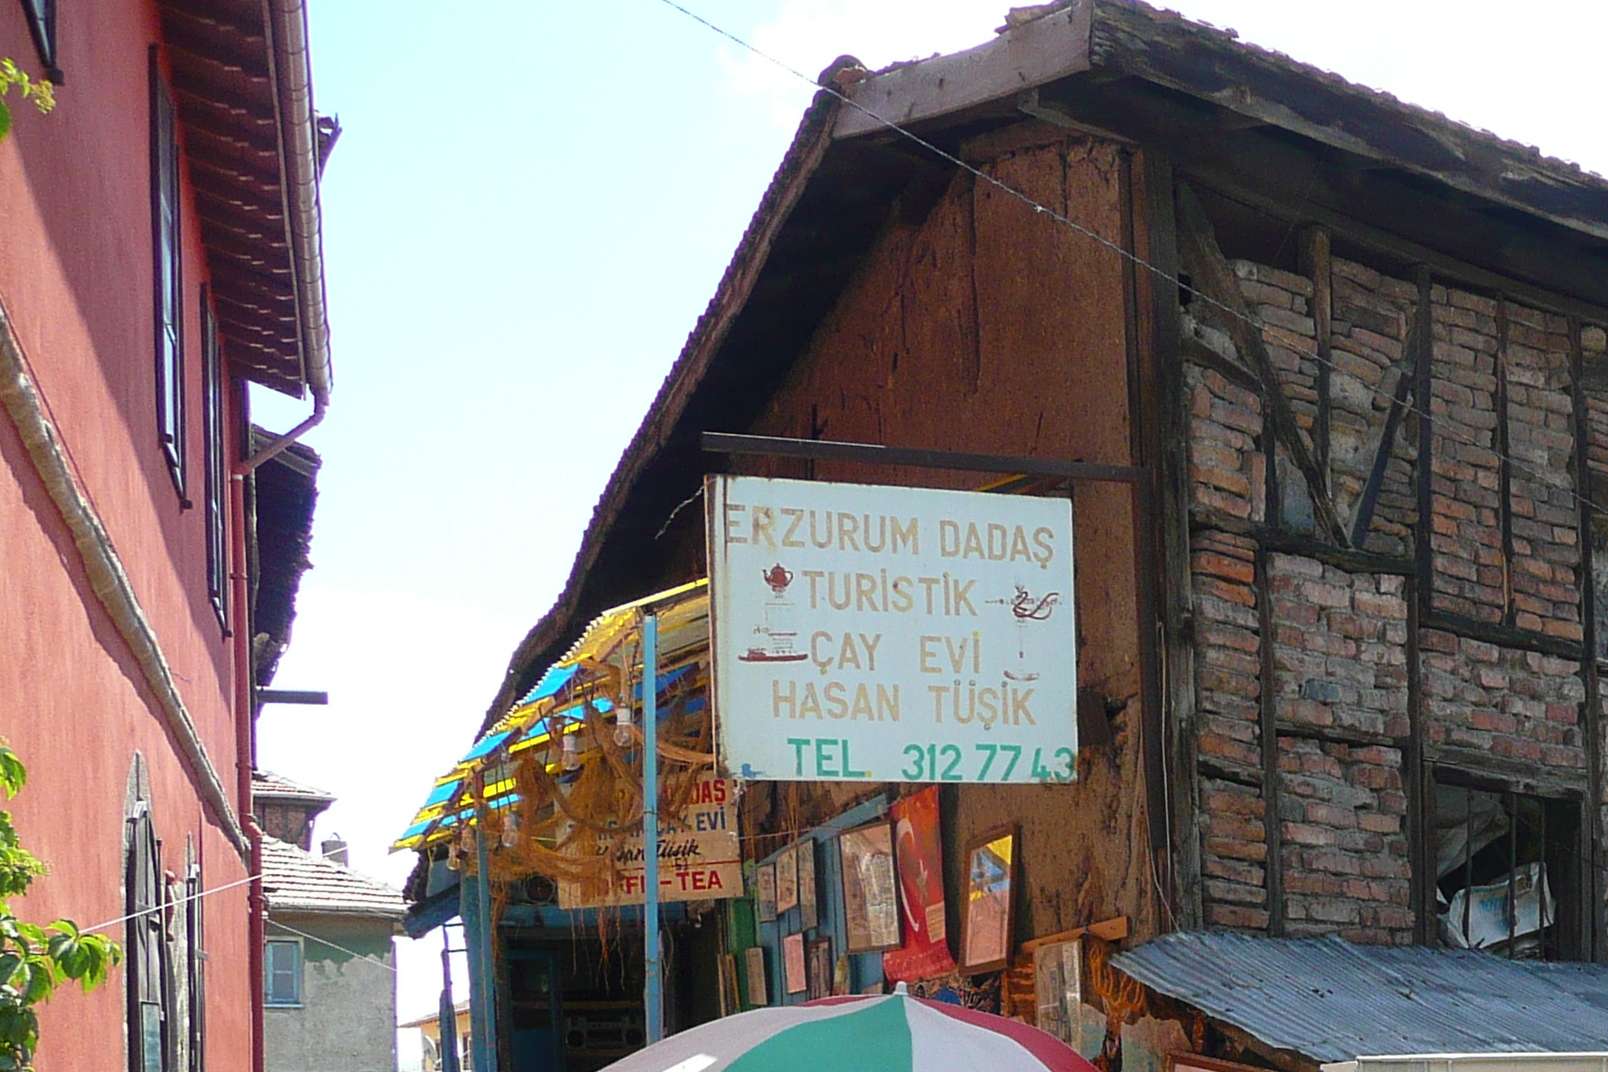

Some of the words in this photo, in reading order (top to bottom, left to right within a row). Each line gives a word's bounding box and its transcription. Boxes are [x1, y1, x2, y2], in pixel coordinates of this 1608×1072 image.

[727, 503, 919, 555] ERZURUM
[939, 519, 1054, 570] DADAŞ
[802, 568, 978, 616] TURİSTİK
[810, 630, 883, 676] ÇAY
[919, 630, 981, 674] EVİ
[772, 679, 900, 722] HASAN
[927, 679, 1037, 731] TÜŞİK
[901, 743, 963, 781] 312
[975, 744, 1022, 782] 77
[1031, 746, 1077, 782] 43
[695, 806, 727, 832] EVİ
[676, 870, 723, 892] TEA
